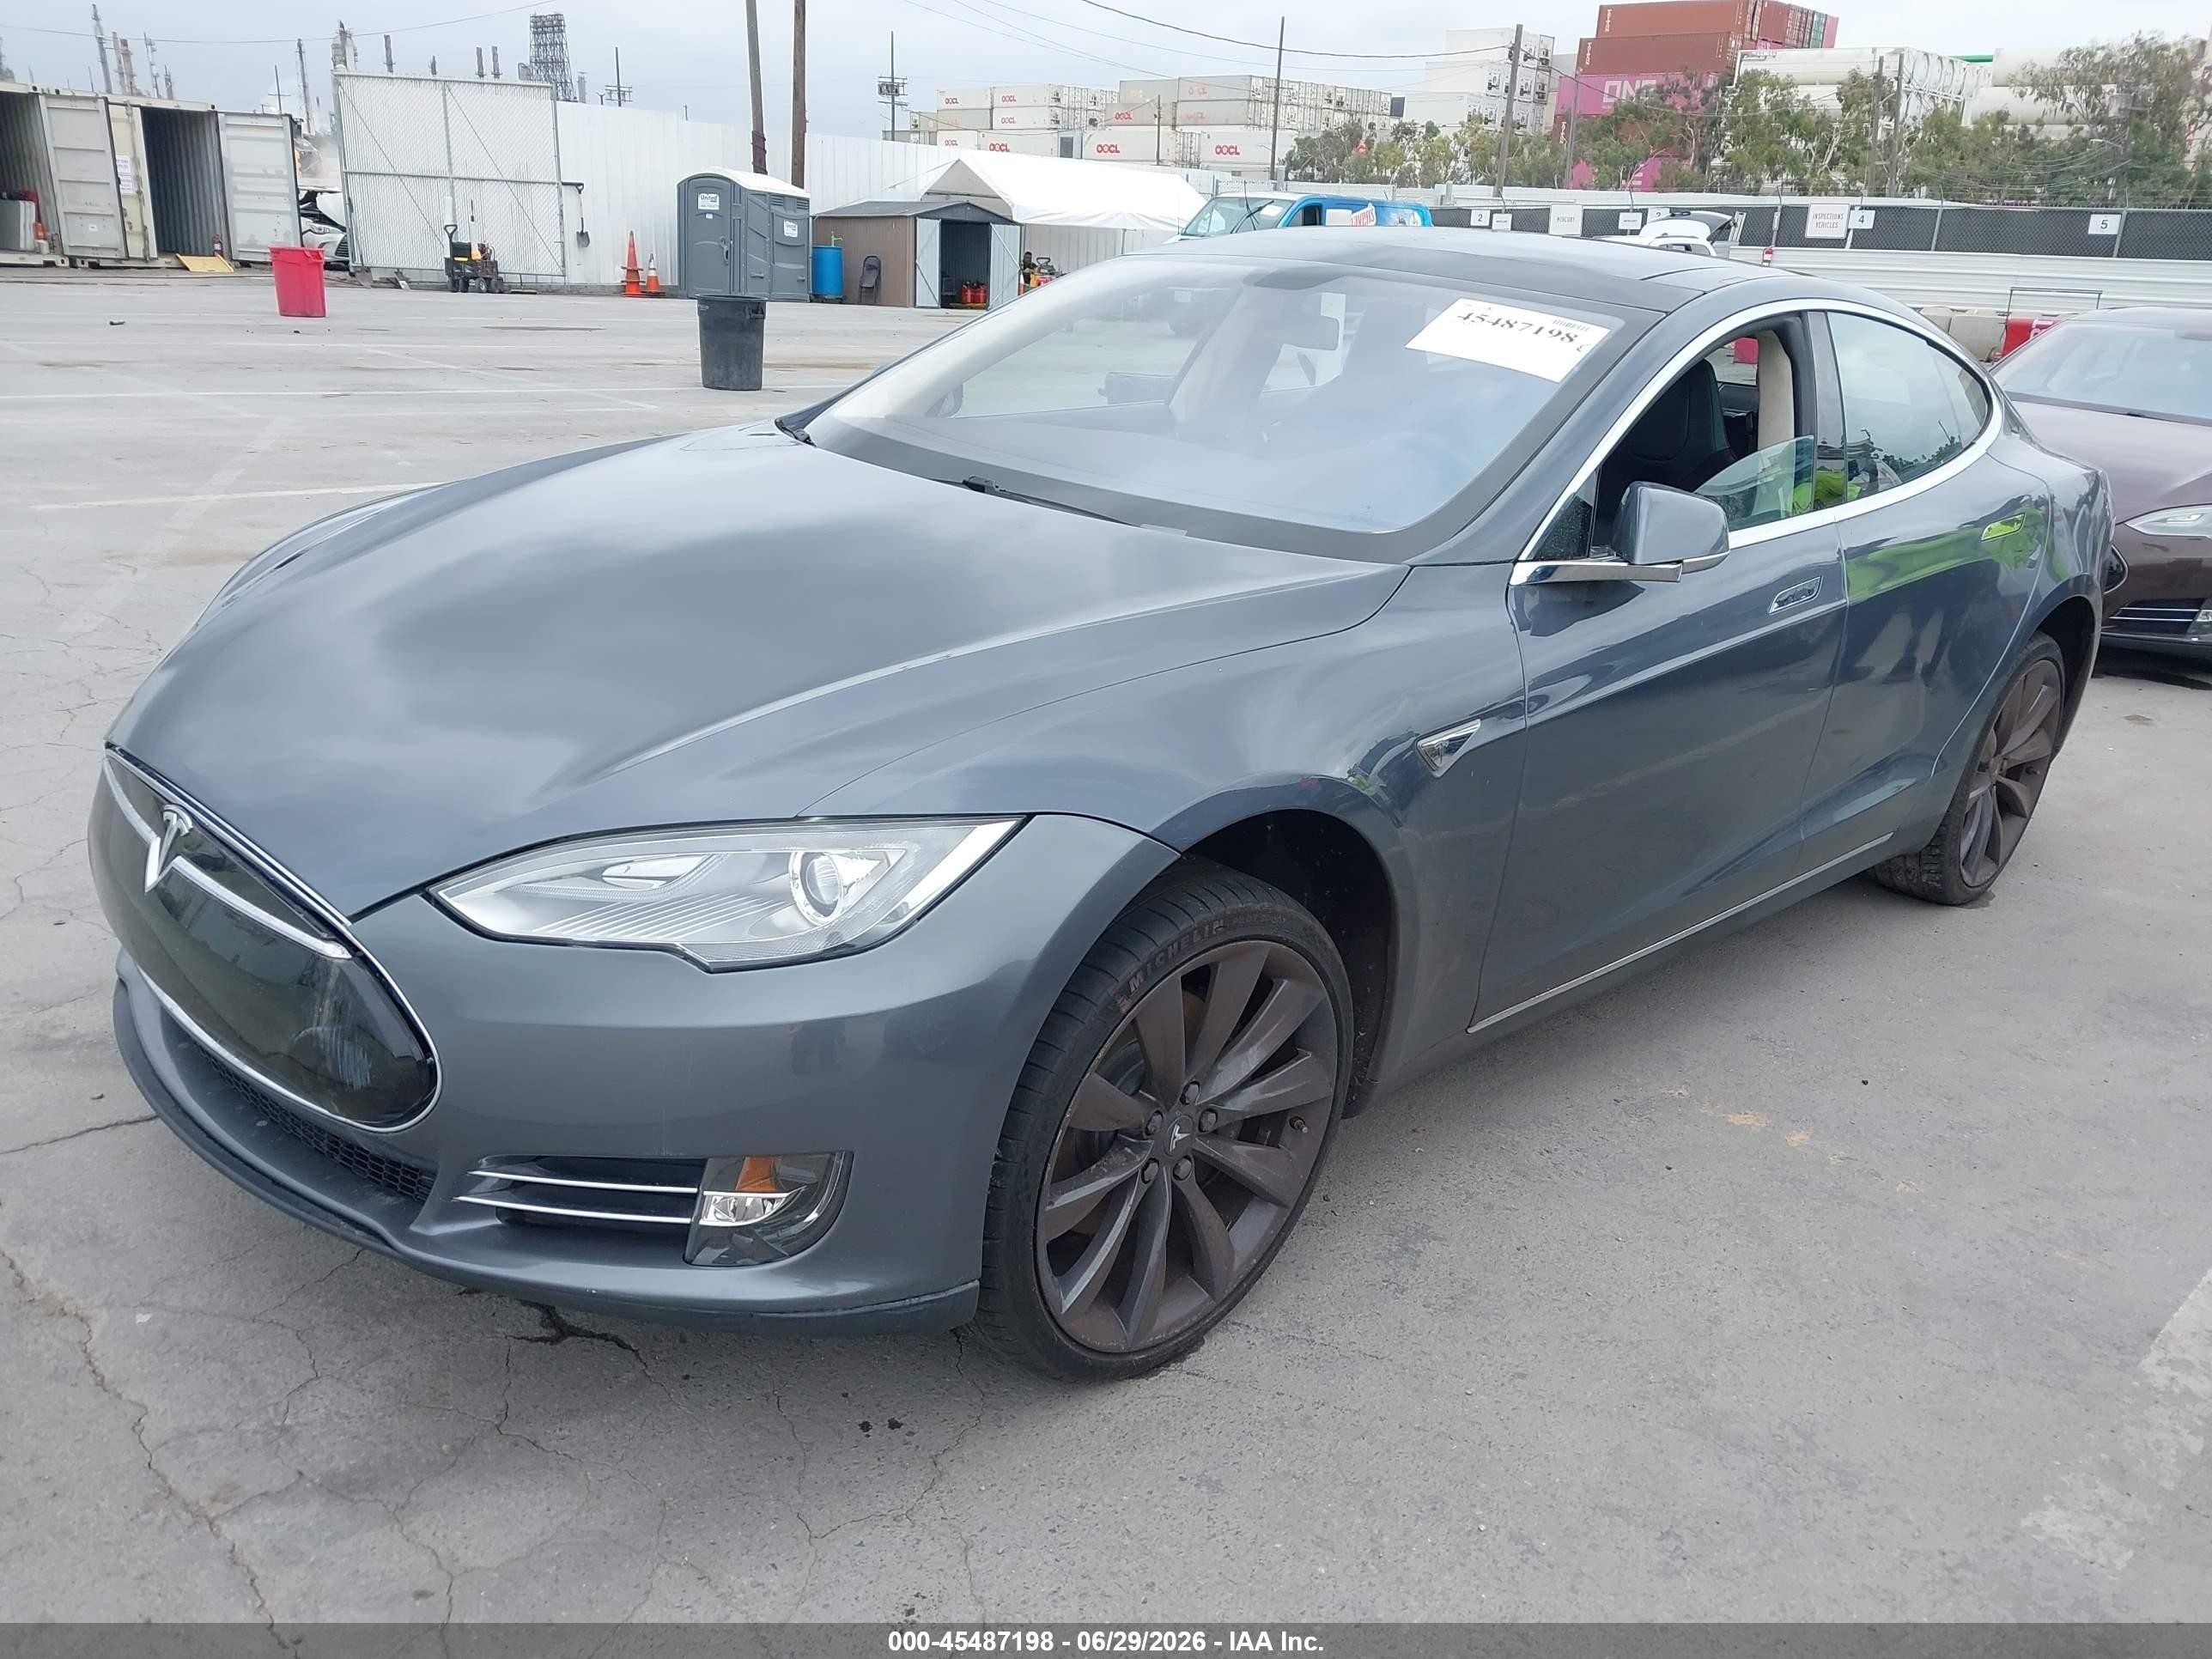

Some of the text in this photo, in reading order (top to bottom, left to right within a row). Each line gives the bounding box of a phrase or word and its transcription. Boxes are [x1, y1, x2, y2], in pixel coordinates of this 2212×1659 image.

[989, 143, 1010, 152] OOCL
[1096, 144, 1120, 154] OOCL
[1215, 145, 1240, 155] OOCL
[1477, 214, 1483, 222] 2
[1858, 215, 1865, 224] 4
[2100, 219, 2108, 229] 5
[1457, 312, 1578, 343] 45487198
[1127, 919, 1224, 993] MICHELIN
